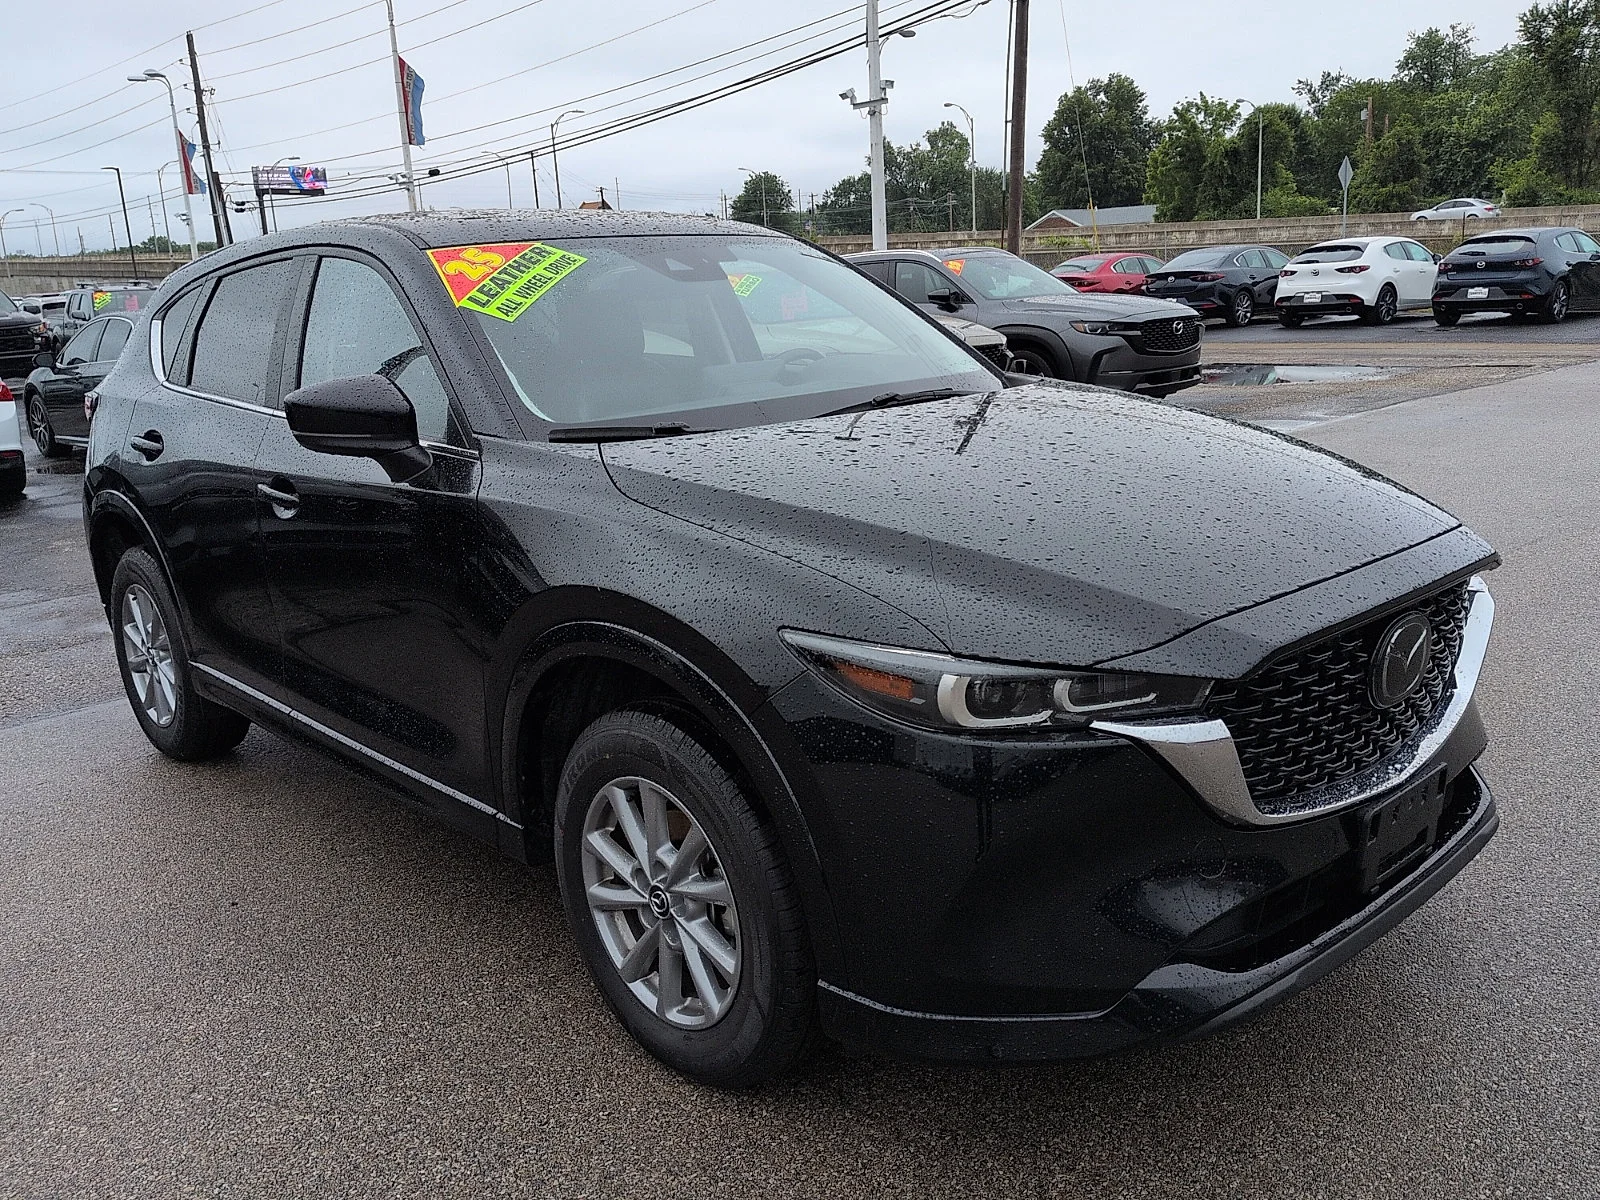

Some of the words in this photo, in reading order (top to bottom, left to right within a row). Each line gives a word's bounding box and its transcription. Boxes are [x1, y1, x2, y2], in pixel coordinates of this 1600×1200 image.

[442, 247, 506, 282] 25
[466, 247, 554, 308] LEATHER
[495, 298, 525, 318] ALL
[512, 272, 552, 300] WHEEL
[543, 253, 581, 280] DRIVE
